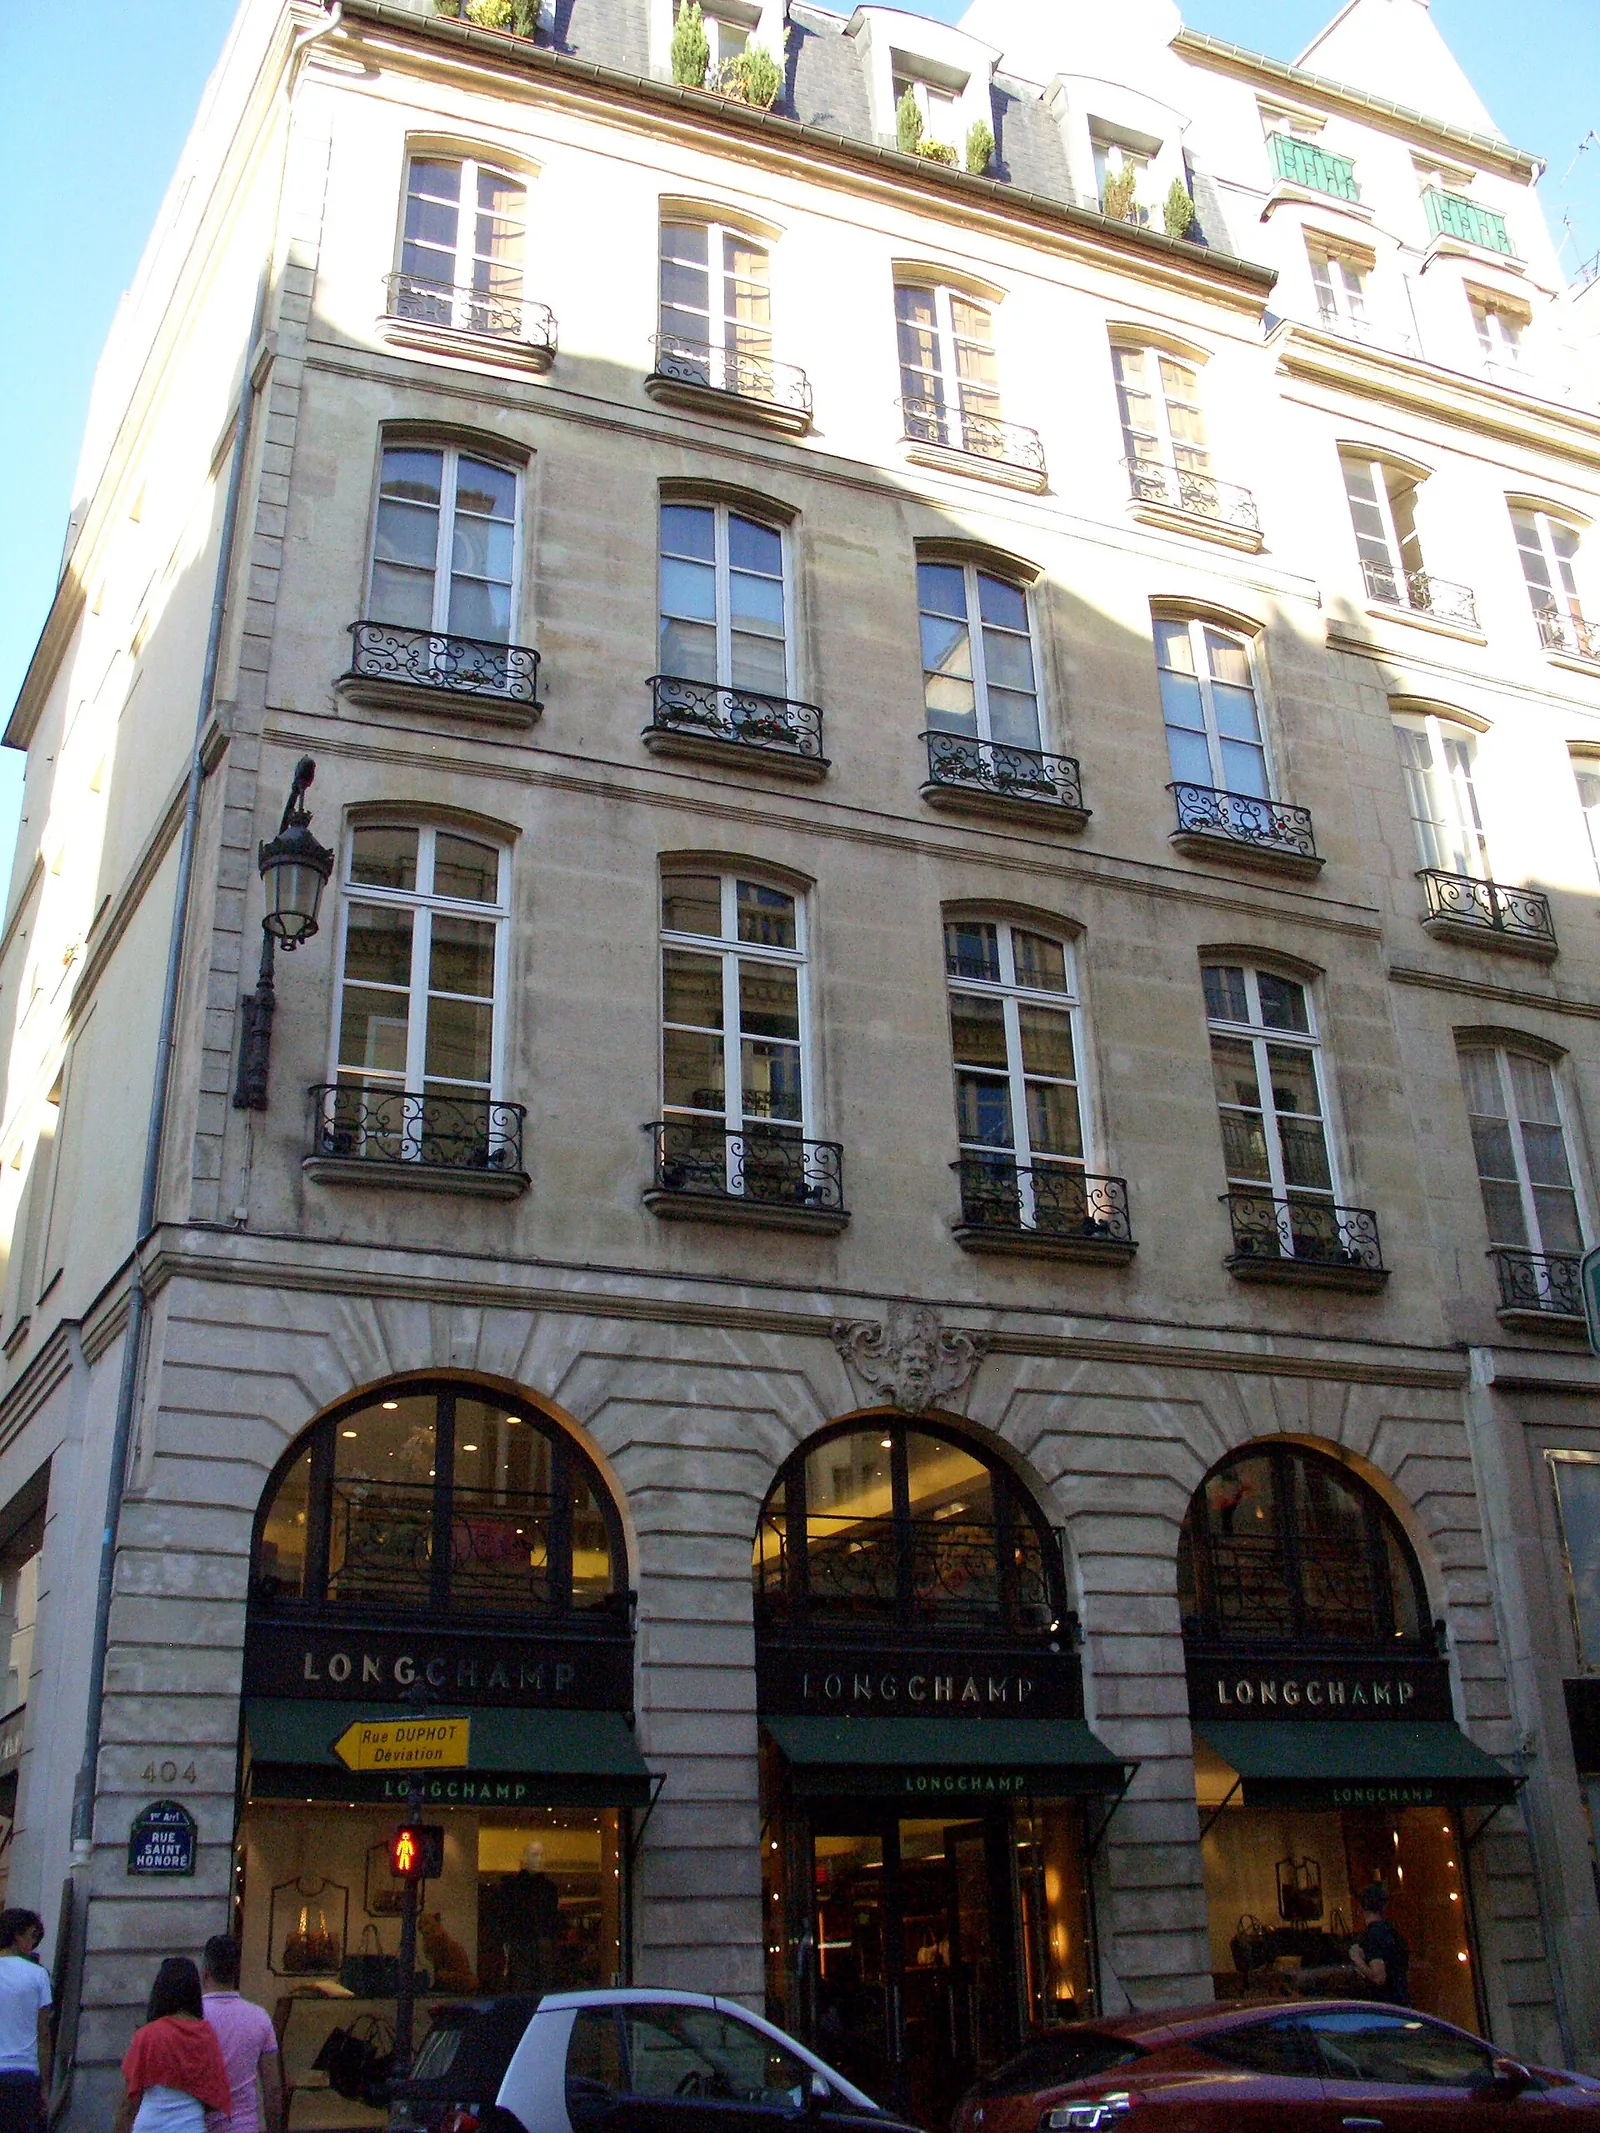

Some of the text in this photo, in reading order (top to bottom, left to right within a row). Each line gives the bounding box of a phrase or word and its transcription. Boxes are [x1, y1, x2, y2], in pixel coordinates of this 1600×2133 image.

[803, 1673, 1033, 1702] LONGCHAMP
[1217, 1680, 1414, 1705] LONGCHAMP
[362, 1726, 458, 1744] Rue DUPHOT
[374, 1747, 443, 1762] Déviation
[141, 1761, 197, 1784] 404
[906, 1776, 1024, 1791] LONGCHAMP
[1333, 1788, 1433, 1802] LONGCHAMP
[151, 1832, 176, 1843] RUE
[145, 1844, 181, 1855] SAINT
[136, 1854, 188, 1867] HONORÉ
